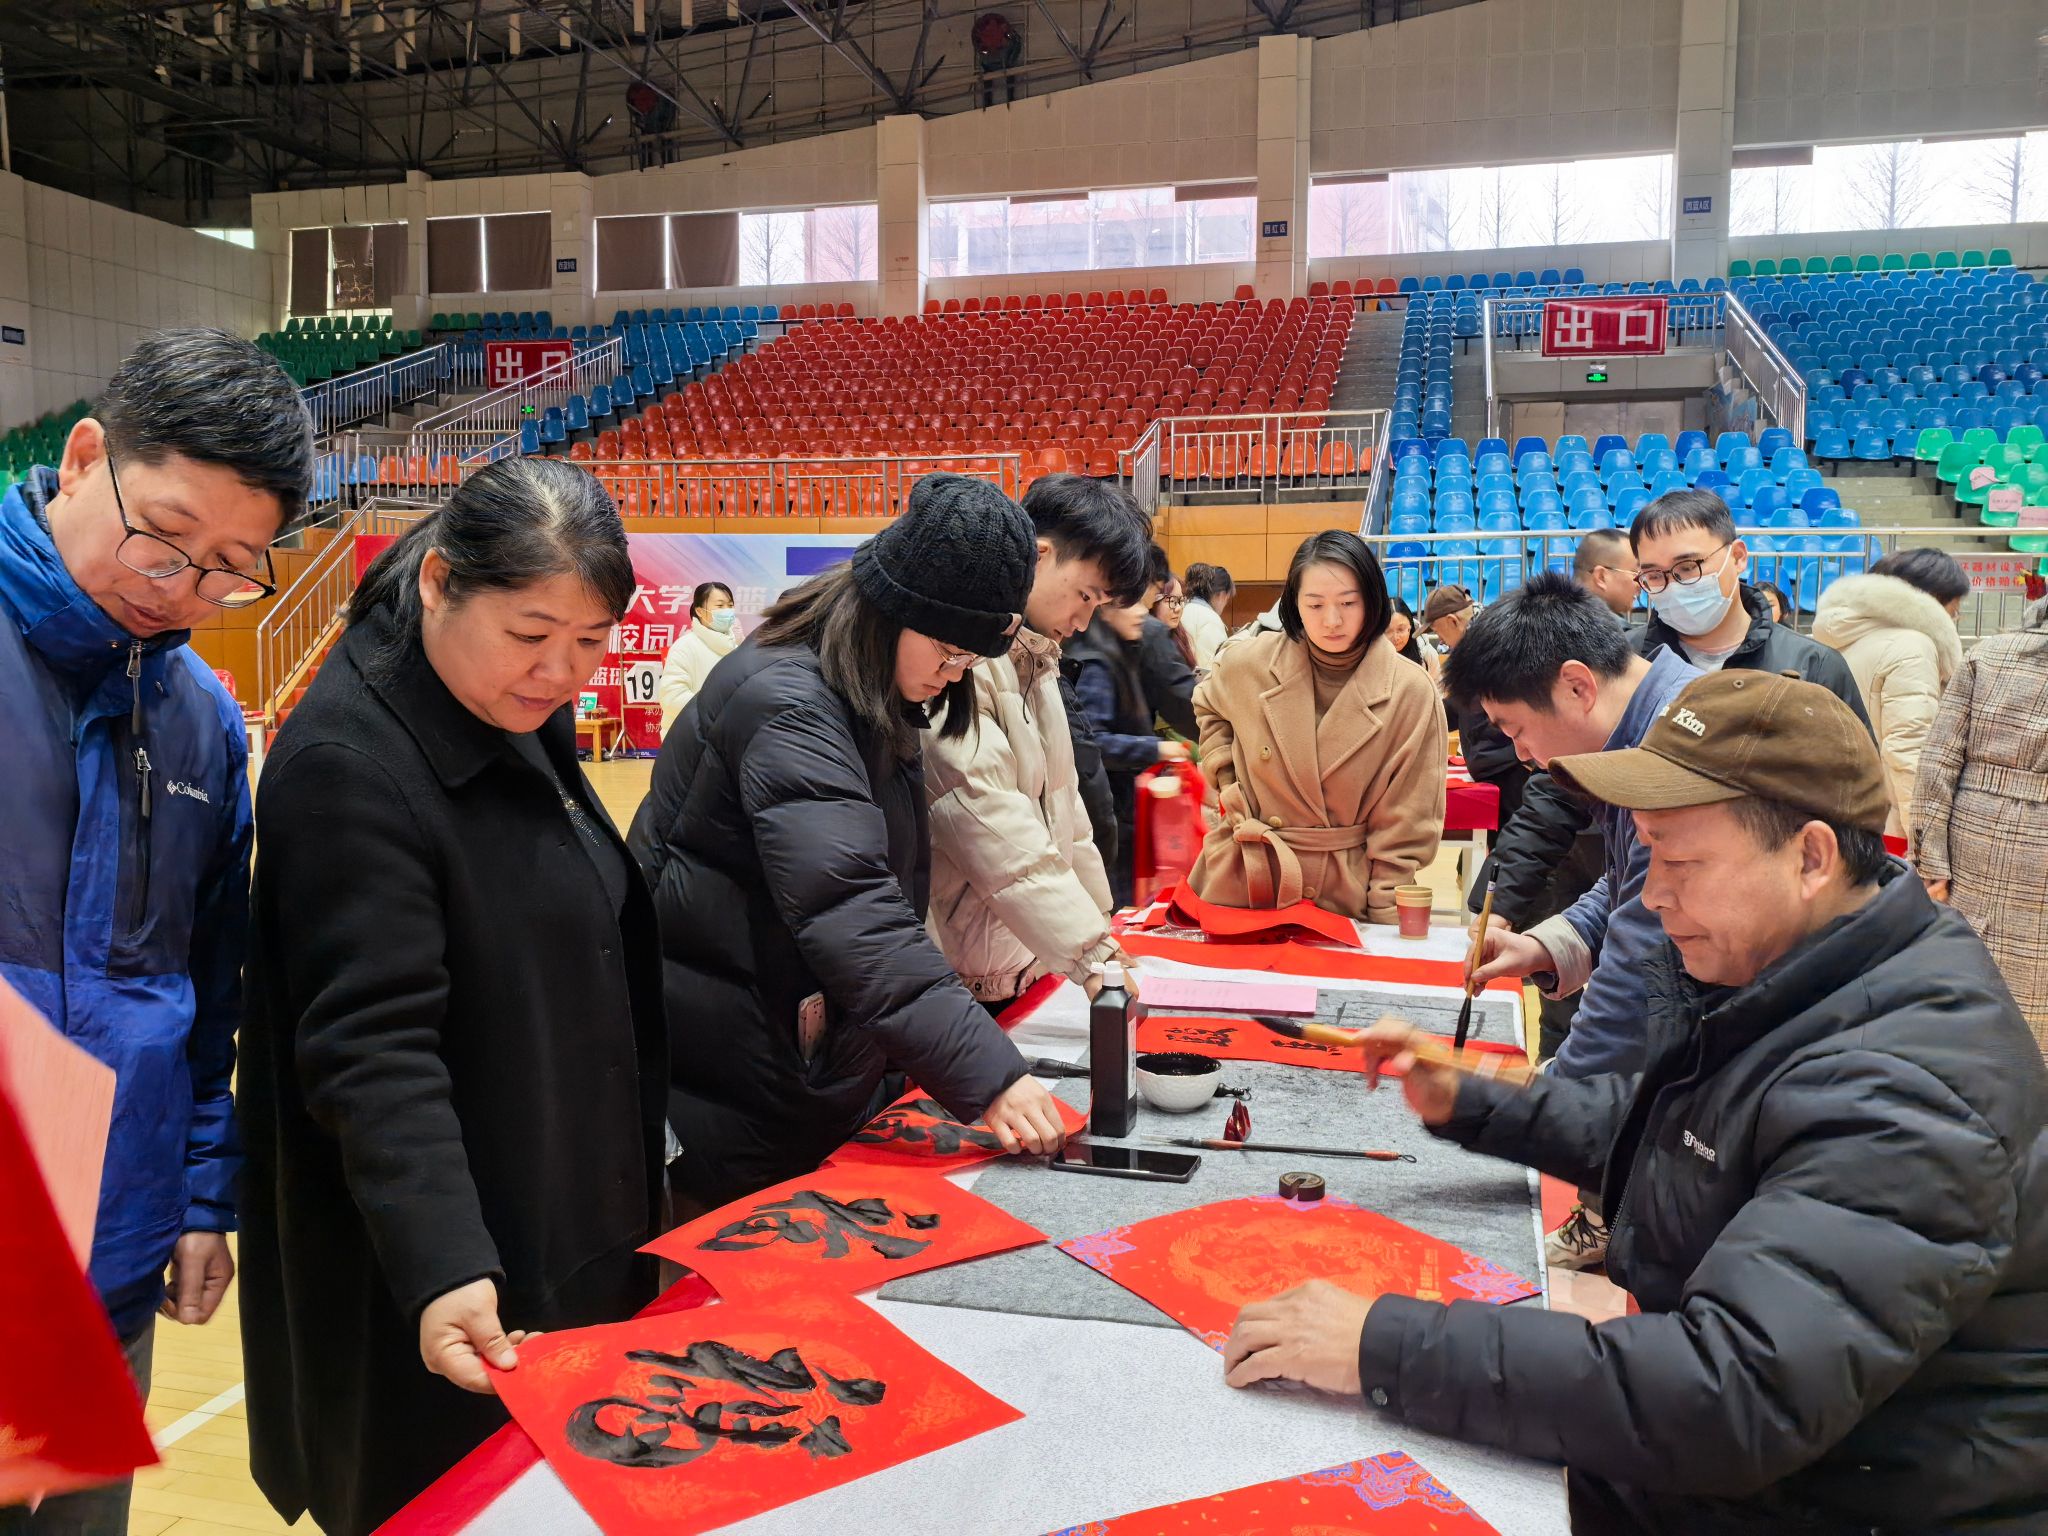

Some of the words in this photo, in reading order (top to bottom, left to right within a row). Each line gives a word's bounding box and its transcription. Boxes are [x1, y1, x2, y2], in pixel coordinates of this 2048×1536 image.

[1554, 307, 1655, 349] 出口
[495, 347, 567, 383] 出口
[608, 624, 690, 654] 校园
[1672, 707, 1706, 736] Kim
